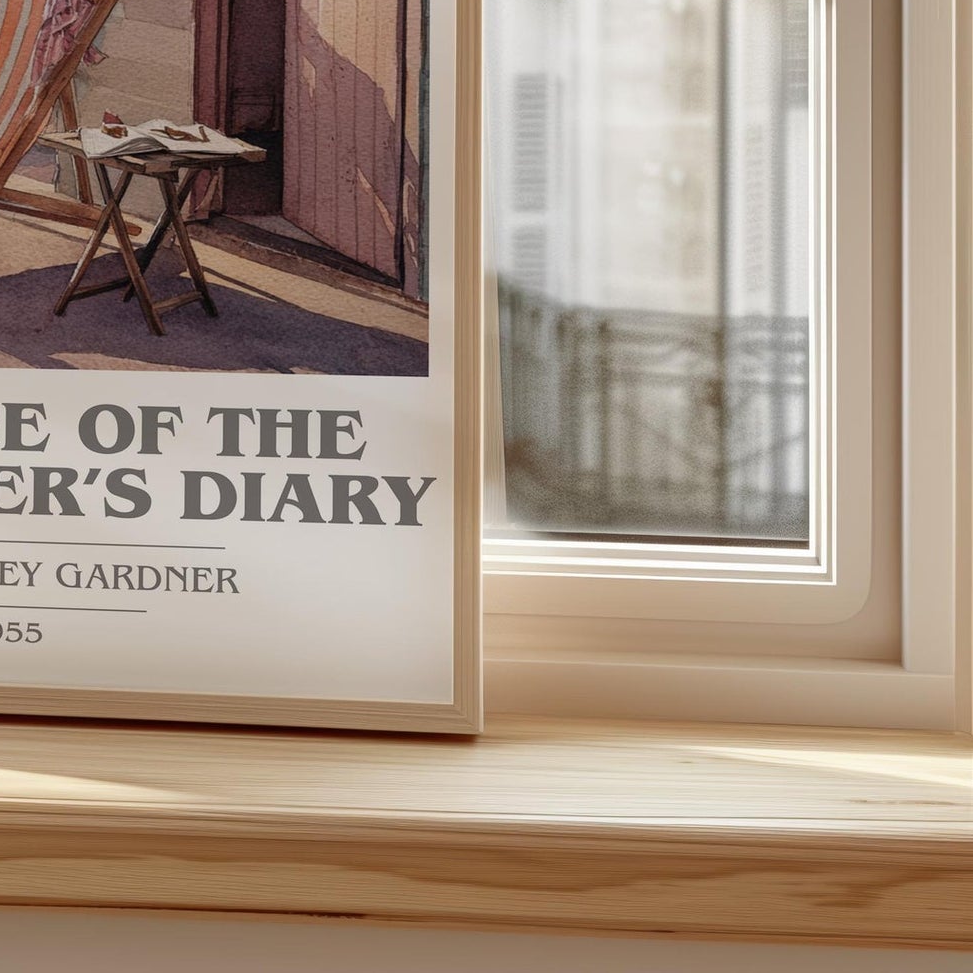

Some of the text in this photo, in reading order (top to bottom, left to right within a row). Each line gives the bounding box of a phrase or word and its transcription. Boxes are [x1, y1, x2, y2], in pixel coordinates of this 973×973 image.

[79, 404, 184, 455] OF
[207, 407, 367, 460] THE
[179, 471, 438, 527] DIARY
[55, 562, 241, 594] GARDNER
